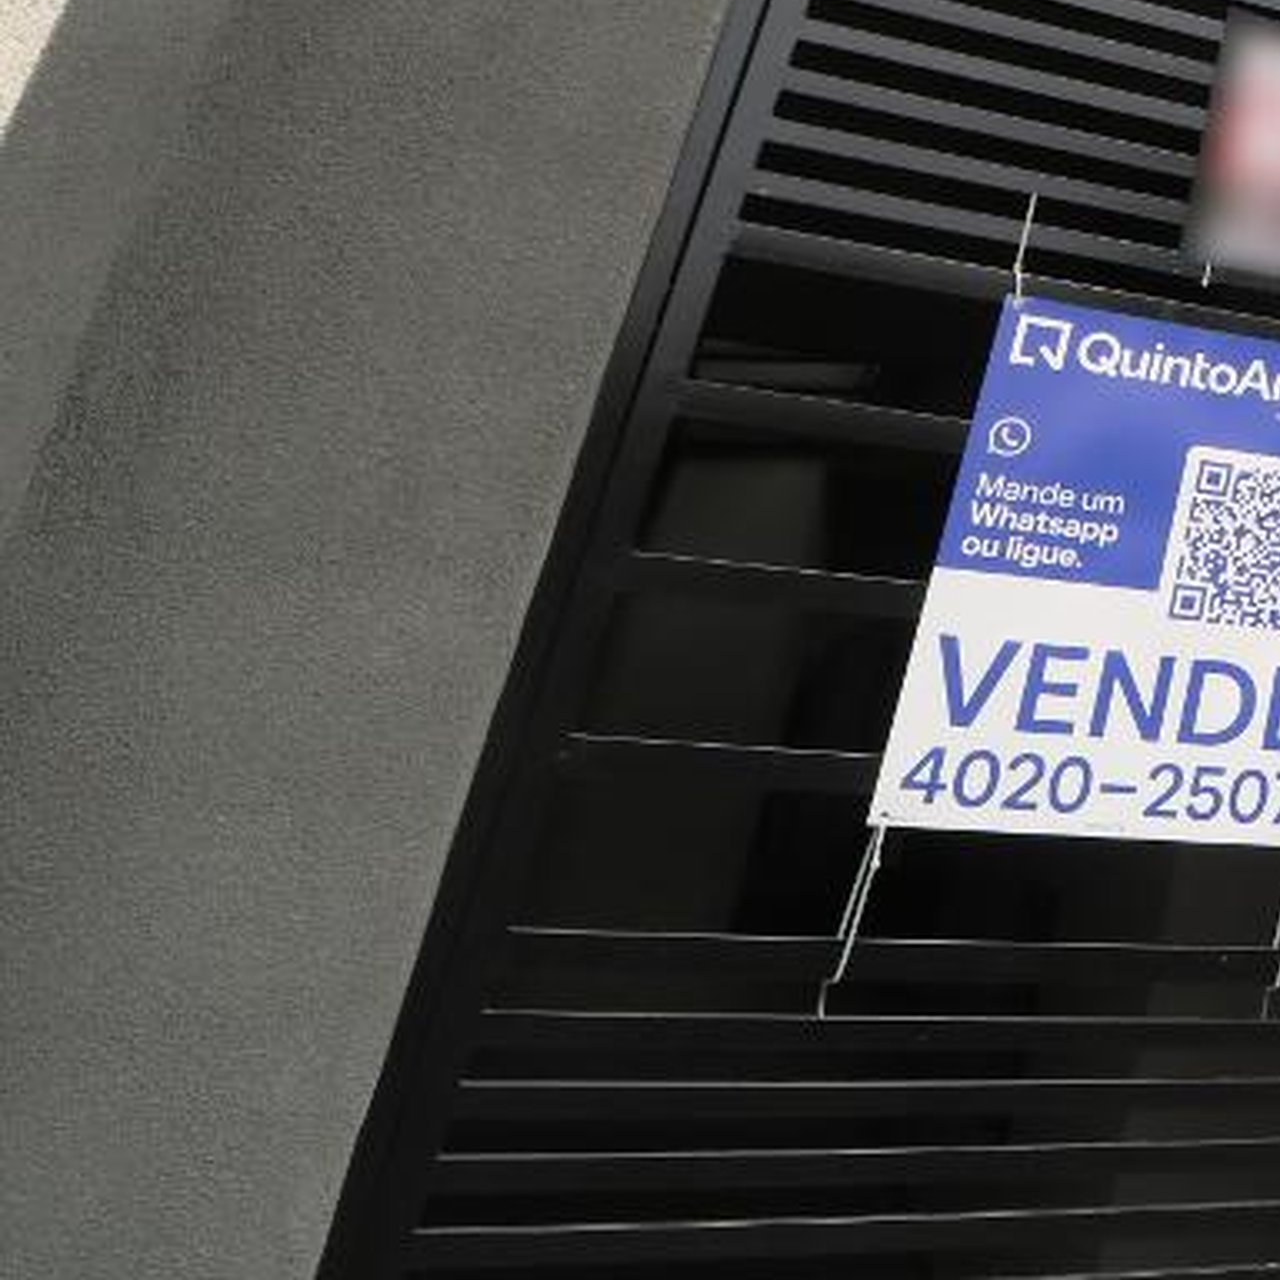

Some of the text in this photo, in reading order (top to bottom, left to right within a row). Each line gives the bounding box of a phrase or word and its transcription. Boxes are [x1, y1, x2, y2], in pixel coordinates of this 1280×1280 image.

[975, 471, 1126, 515] Mande um
[970, 499, 1120, 548] Whatsapp
[961, 535, 1083, 568] ou ligue.
